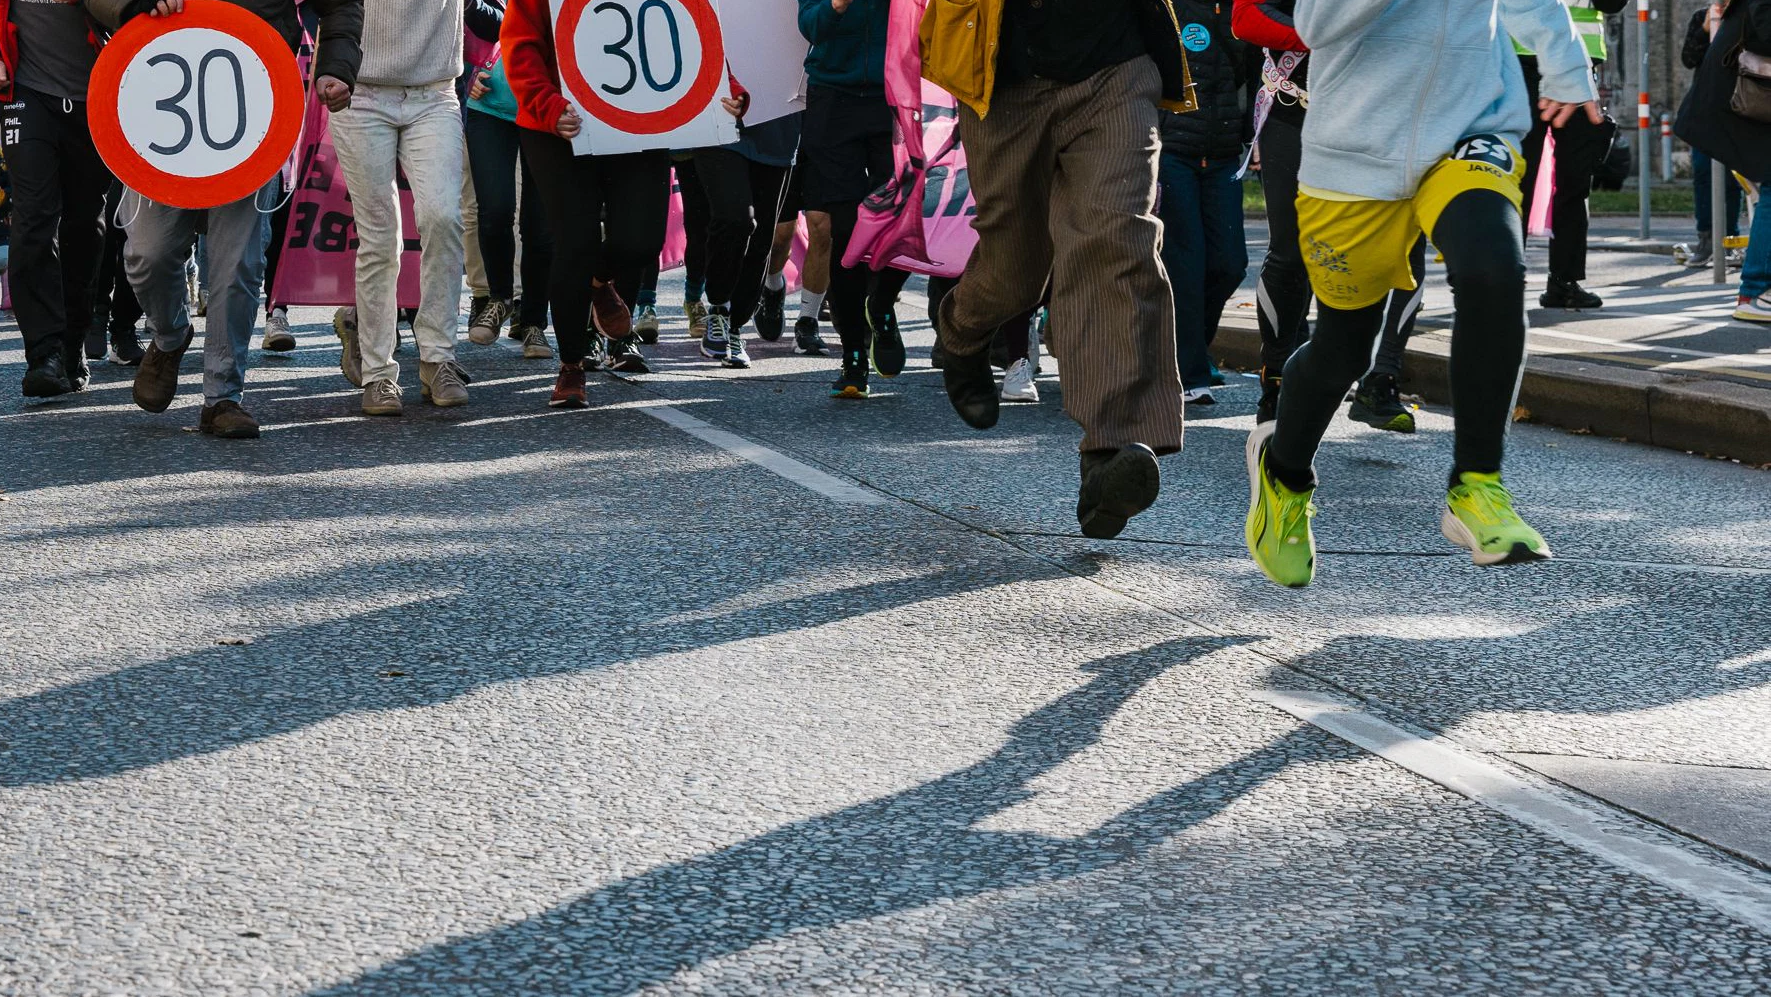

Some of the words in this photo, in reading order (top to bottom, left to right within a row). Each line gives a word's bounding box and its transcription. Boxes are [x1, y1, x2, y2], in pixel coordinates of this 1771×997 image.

[146, 47, 248, 156] 30
[4, 117, 22, 127] PHIL
[5, 128, 20, 146] 21
[1467, 164, 1503, 178] JAKO
